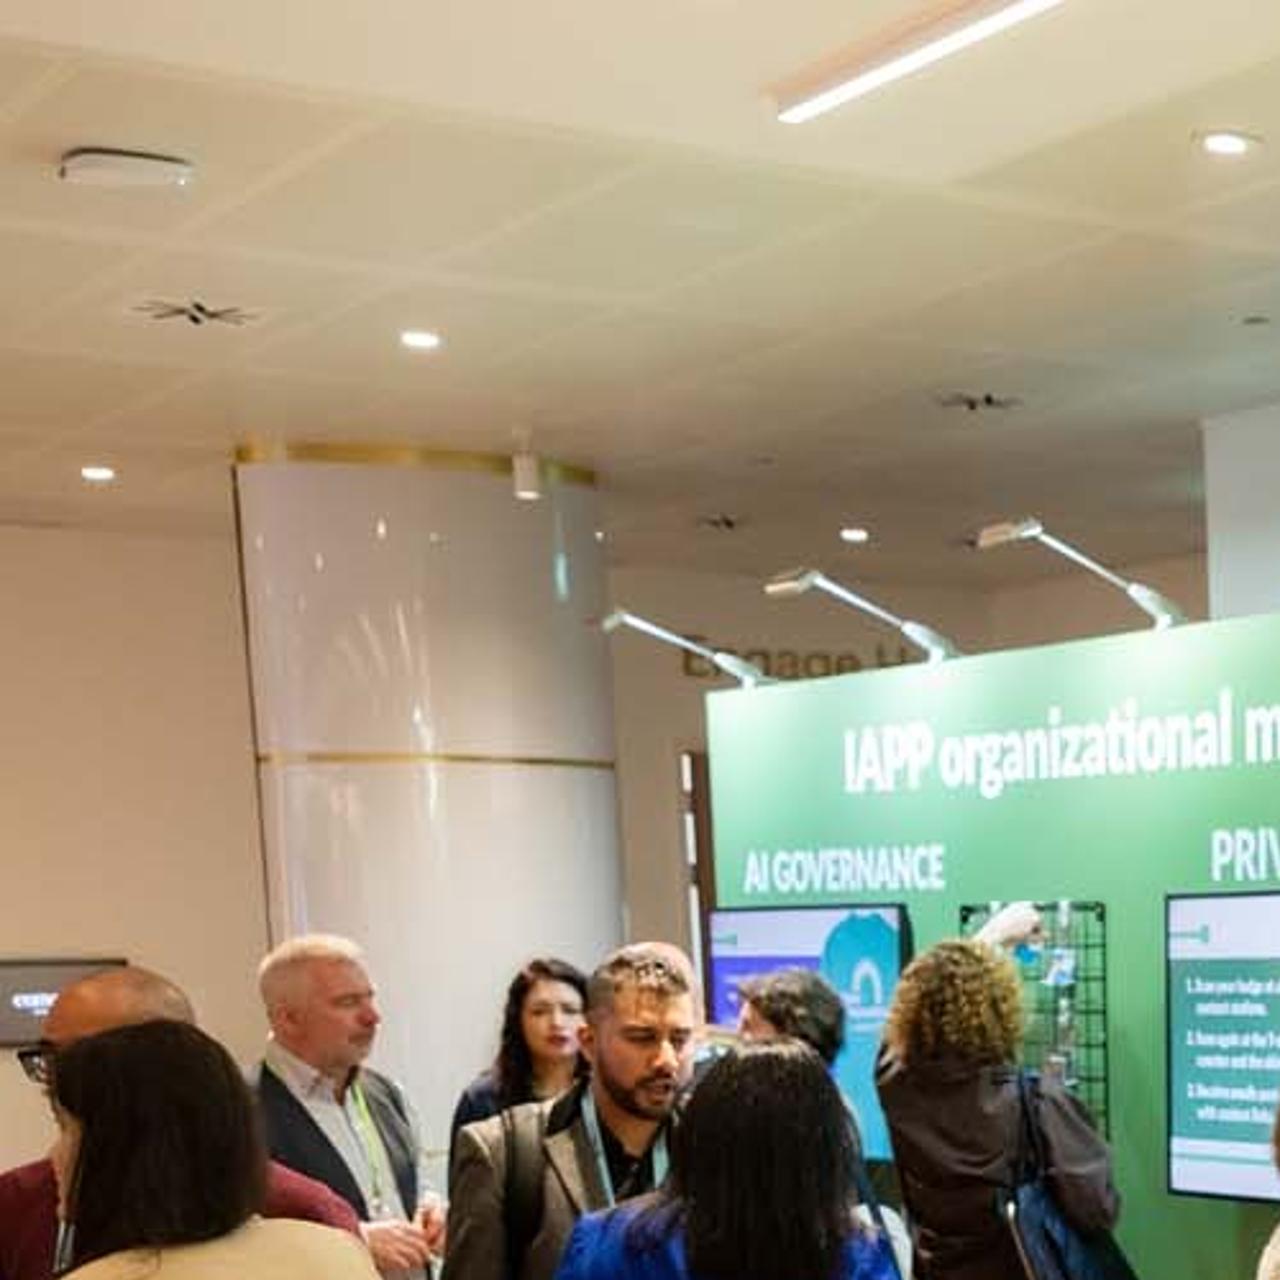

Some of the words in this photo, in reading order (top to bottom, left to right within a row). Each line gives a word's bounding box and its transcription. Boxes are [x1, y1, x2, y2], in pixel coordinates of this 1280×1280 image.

[843, 719, 934, 794] IAPP
[939, 688, 1233, 799] organizational
[743, 850, 770, 894] AI
[772, 844, 945, 893] GOVERNANCE
